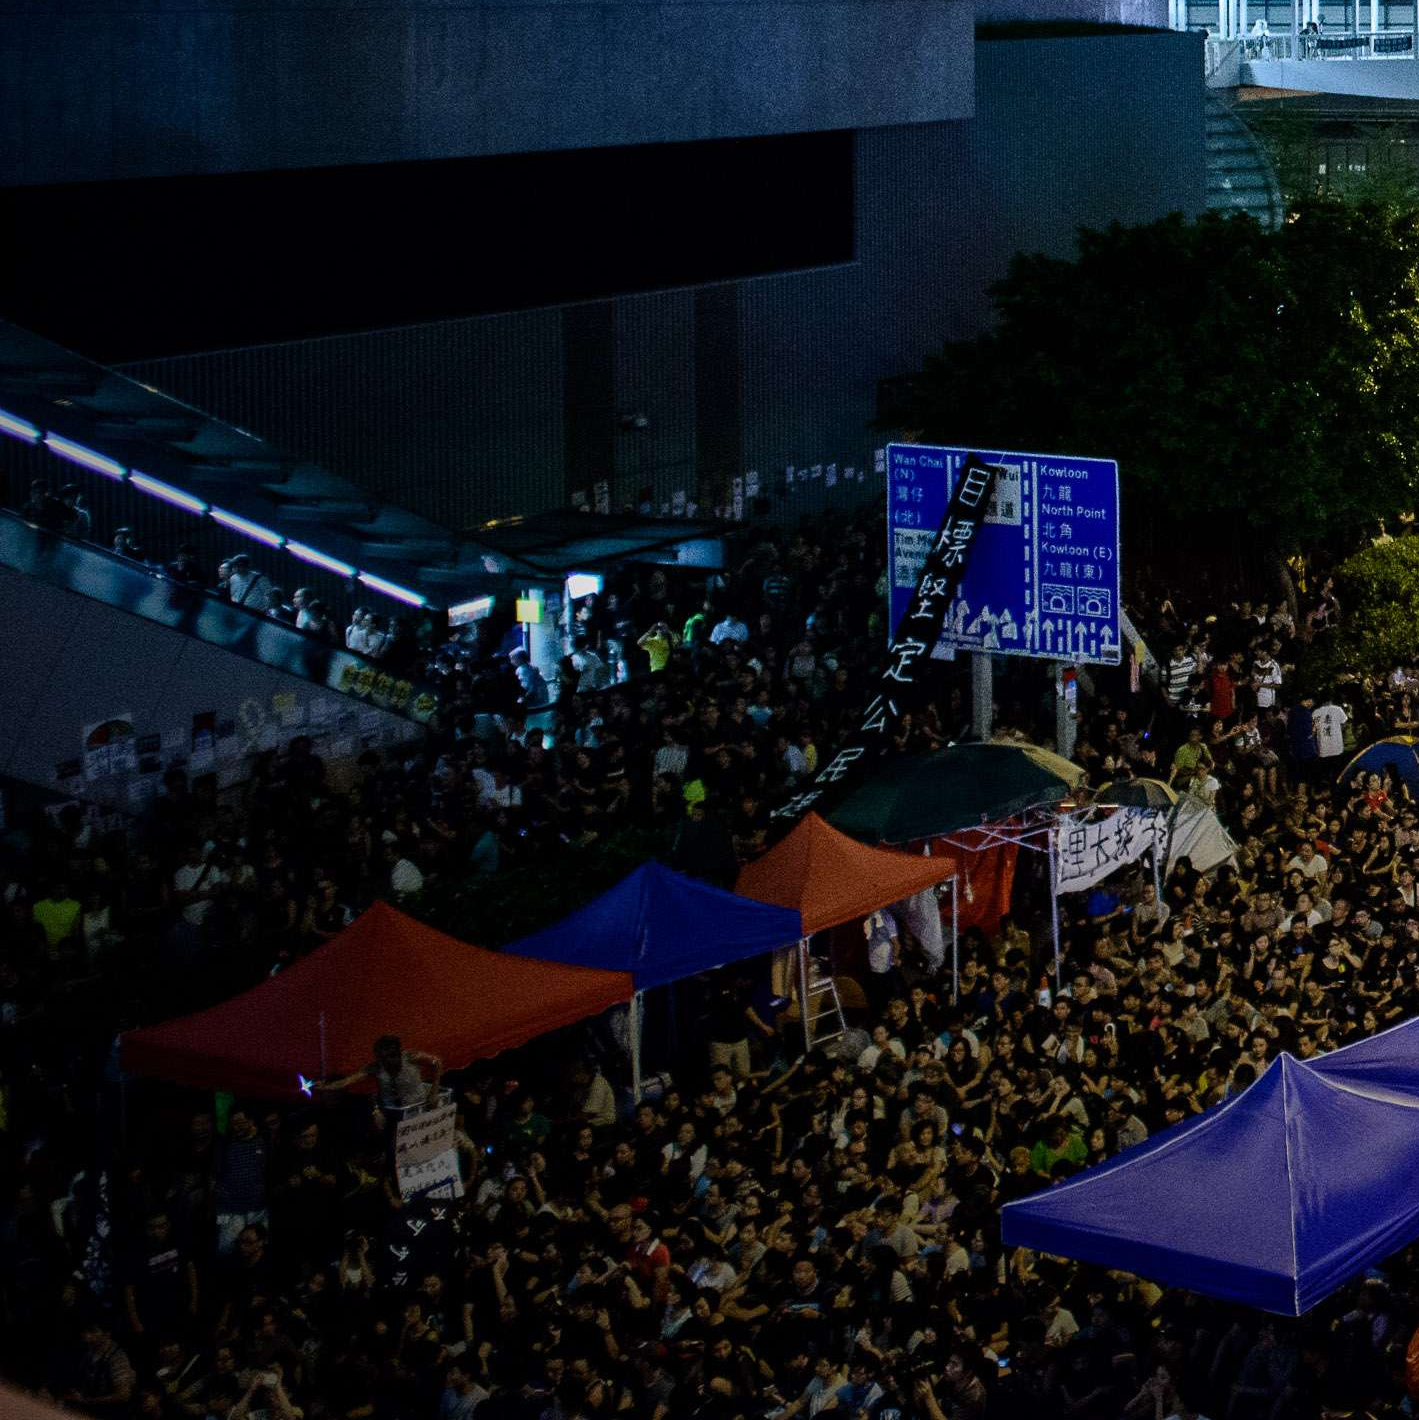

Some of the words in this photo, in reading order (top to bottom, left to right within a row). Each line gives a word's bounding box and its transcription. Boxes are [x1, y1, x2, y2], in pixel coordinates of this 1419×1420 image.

[893, 453, 916, 466] Wan
[919, 455, 944, 469] Chai
[894, 468, 915, 482] (N)
[1040, 465, 1089, 480] Kowloon
[1042, 484, 1073, 502] 九龍
[895, 508, 921, 526] (北)
[1041, 503, 1074, 517] North
[1076, 505, 1107, 520] Point
[1042, 523, 1073, 539] 北角
[1041, 541, 1089, 557] Kowloon
[1093, 545, 1113, 561] (E)
[1043, 562, 1103, 581] 九龍(東)
